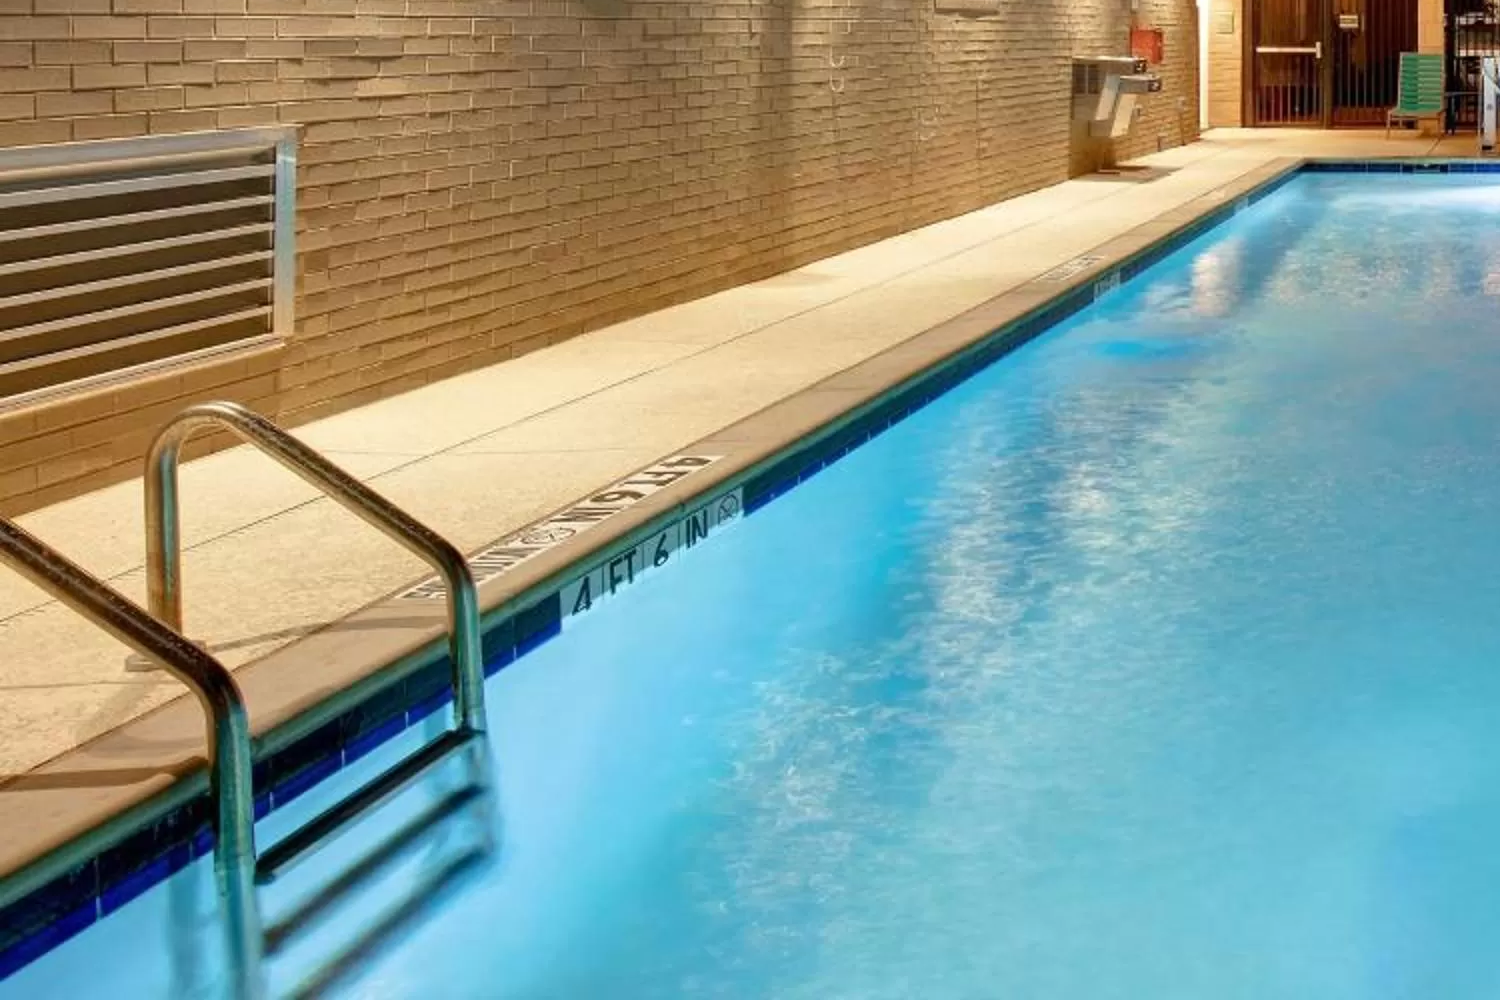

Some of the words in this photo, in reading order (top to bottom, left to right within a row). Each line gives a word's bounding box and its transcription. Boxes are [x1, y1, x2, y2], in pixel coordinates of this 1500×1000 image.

[623, 470, 690, 487] FT
[590, 490, 647, 502] 6
[550, 507, 622, 522] IN
[572, 575, 592, 616] 4
[609, 548, 637, 595] FT
[653, 533, 669, 568] 6
[686, 509, 708, 548] IN
